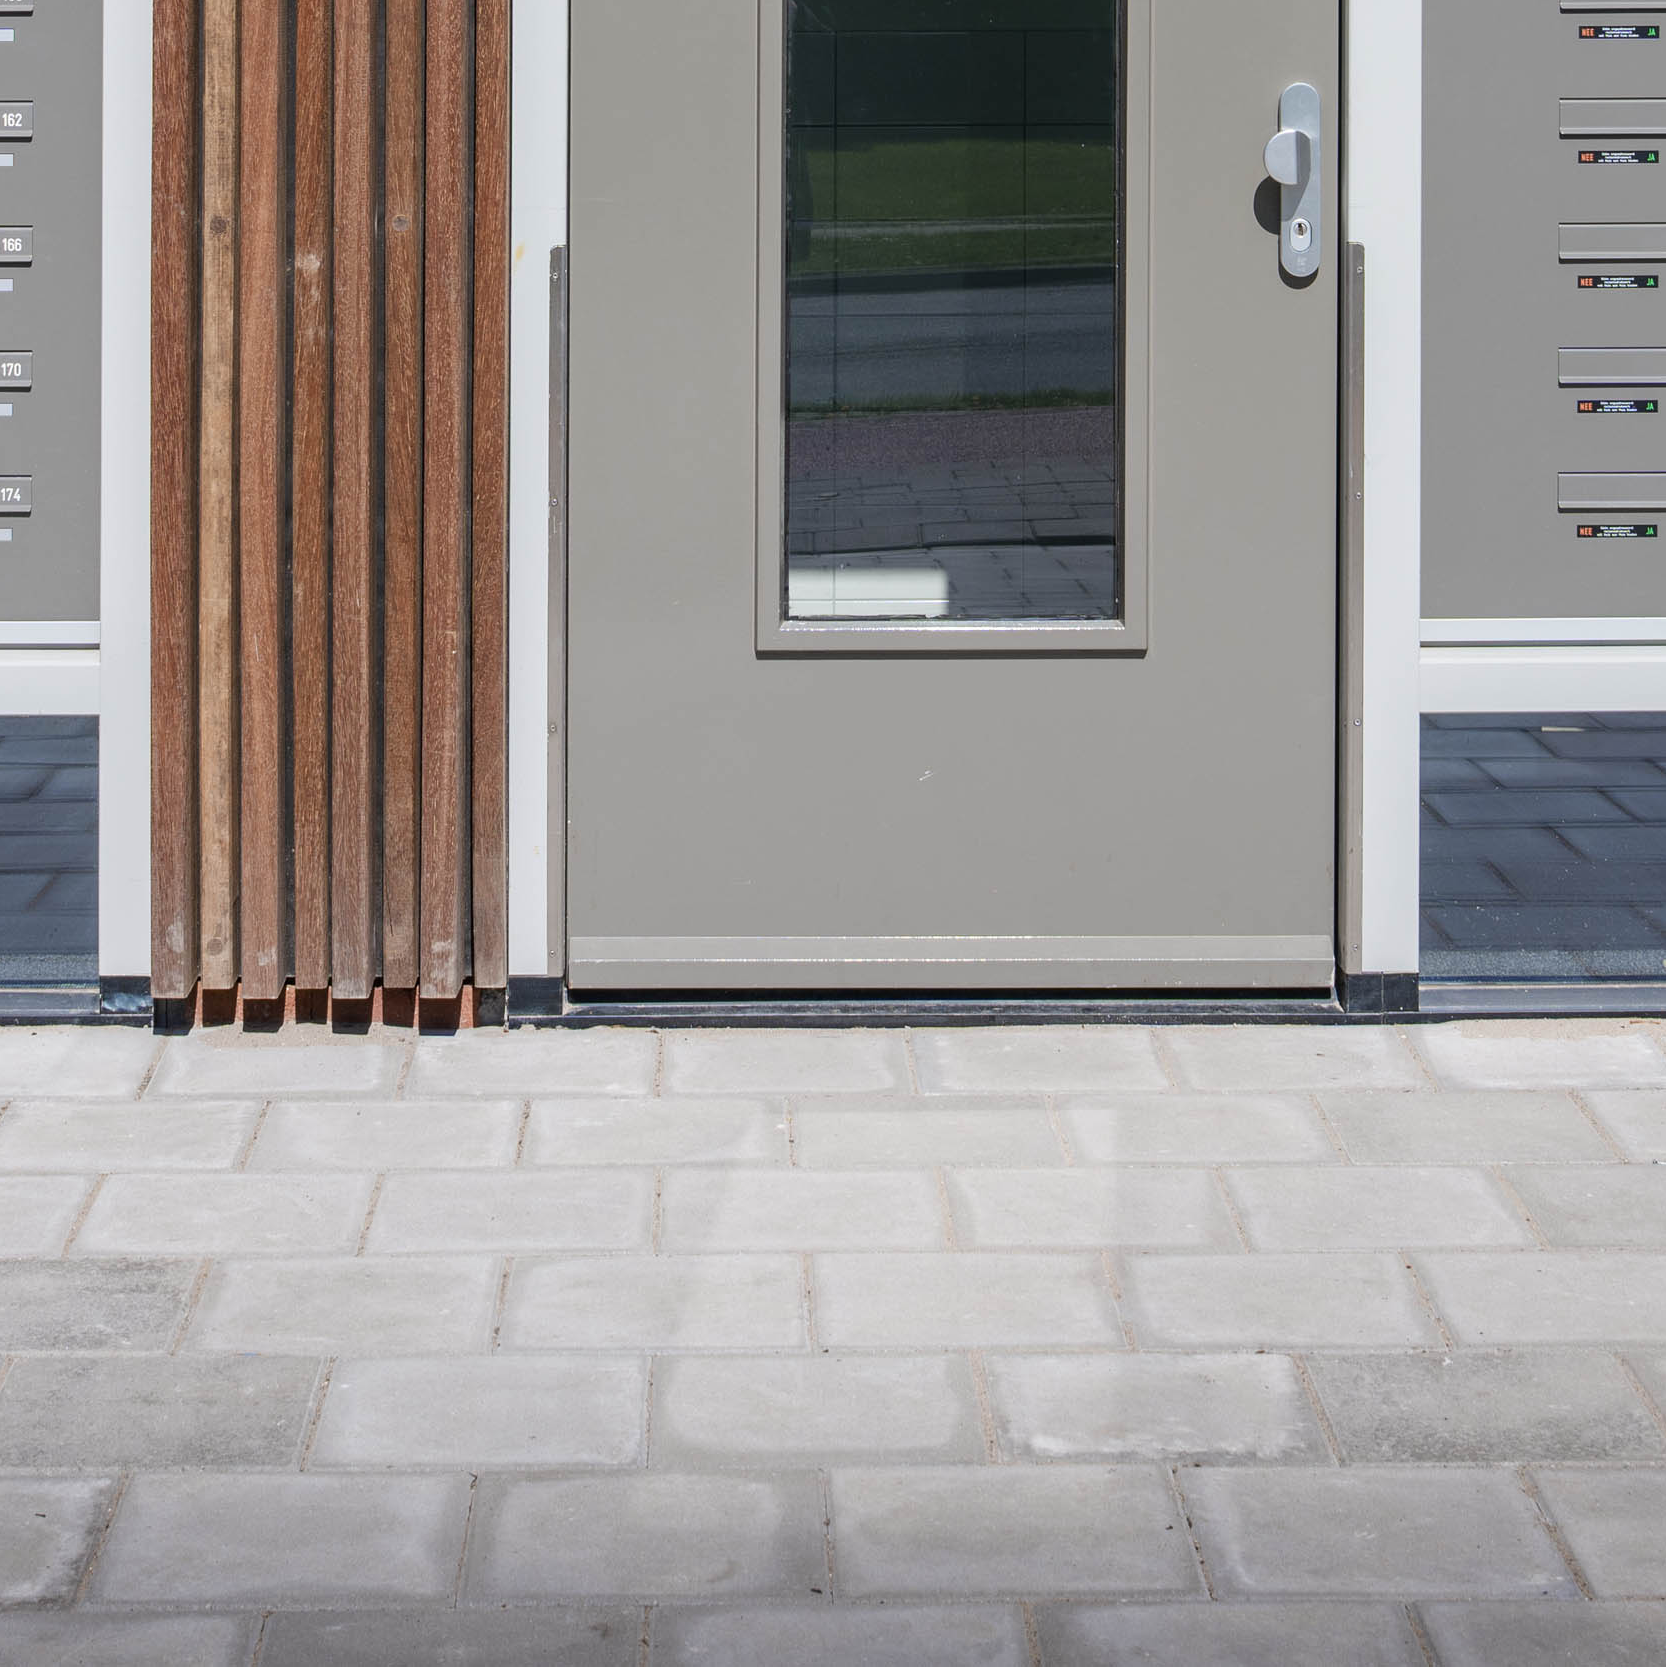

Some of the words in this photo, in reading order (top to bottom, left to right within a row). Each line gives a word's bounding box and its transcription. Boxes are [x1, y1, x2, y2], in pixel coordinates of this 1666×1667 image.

[1582, 28, 1594, 36] NEE
[1648, 28, 1656, 36] JA
[2, 113, 22, 127] 162
[1581, 153, 1594, 161] NEE
[1647, 153, 1655, 161] JA
[2, 238, 22, 251] 166
[1581, 278, 1593, 286] NEE
[1646, 278, 1654, 286] JA
[1, 363, 21, 377] 170
[1580, 403, 1592, 411] NEE
[1645, 403, 1653, 411] JA
[0, 488, 21, 501] 174
[1580, 527, 1592, 536] NEE
[1645, 527, 1653, 535] JA
